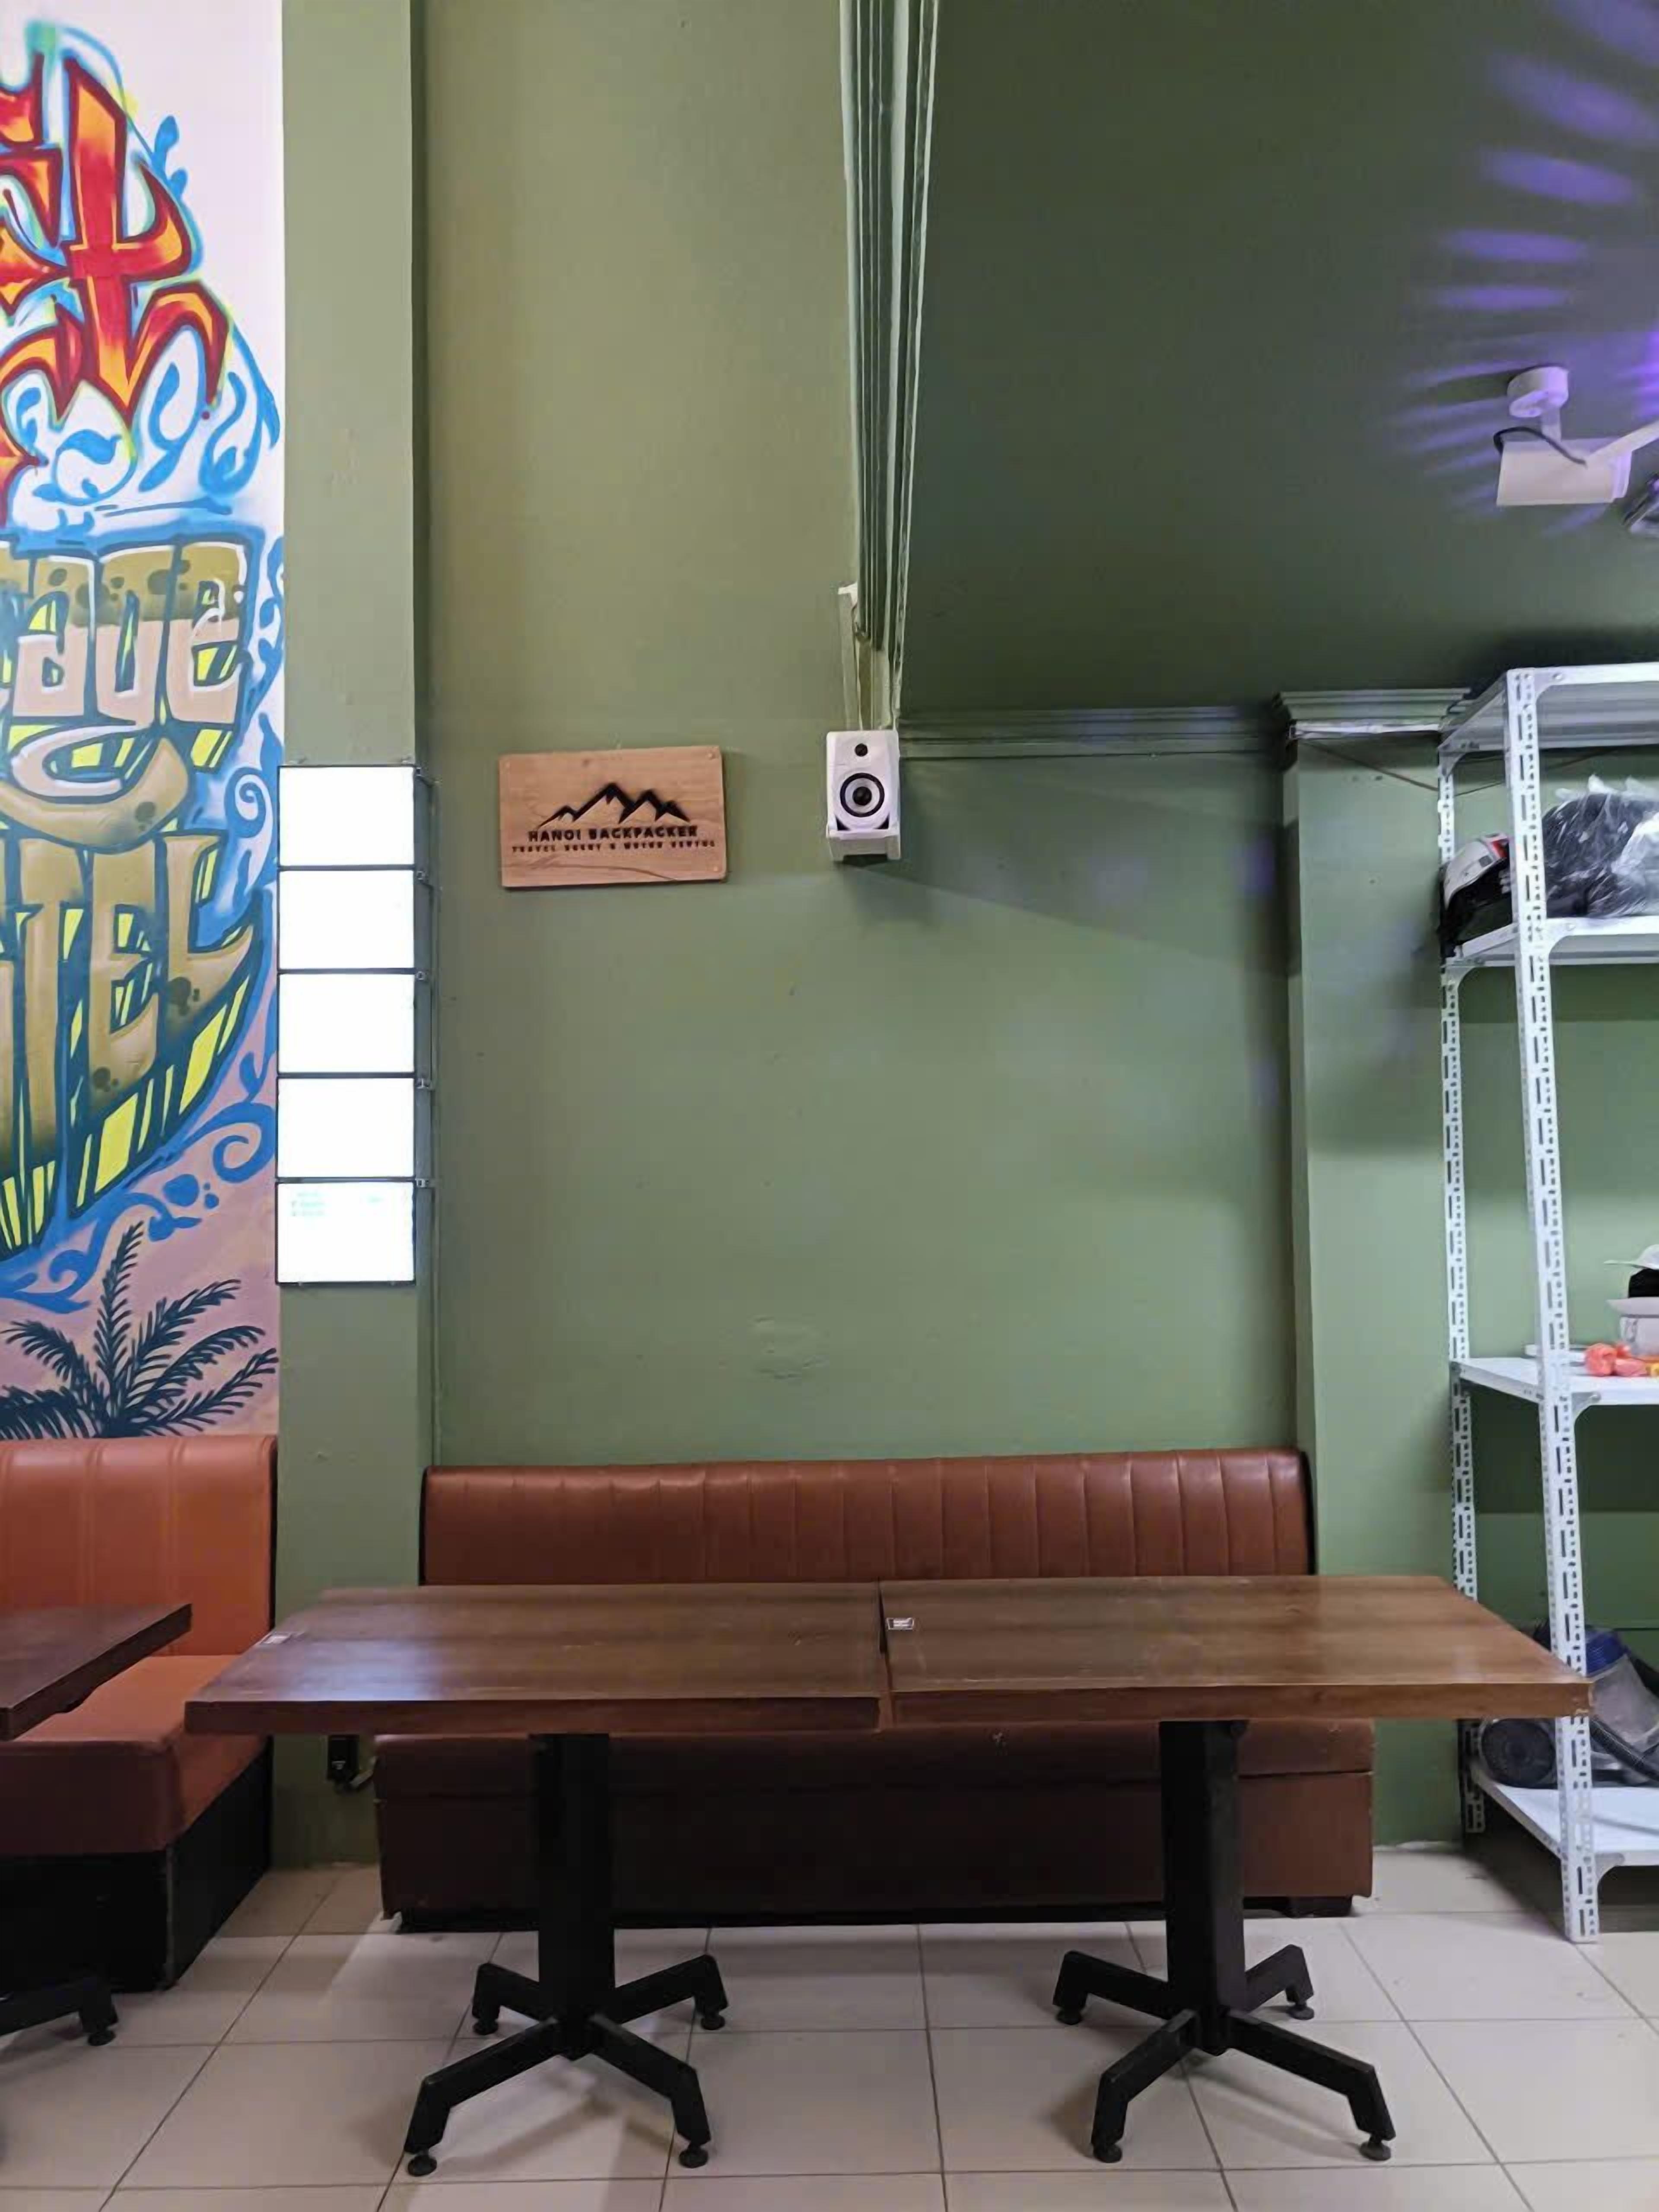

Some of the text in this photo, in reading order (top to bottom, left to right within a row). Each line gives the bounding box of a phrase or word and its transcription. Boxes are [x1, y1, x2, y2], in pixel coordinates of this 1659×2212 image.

[528, 824, 698, 842] HANOI BACKPACKER
[0, 827, 257, 1184] TEL
